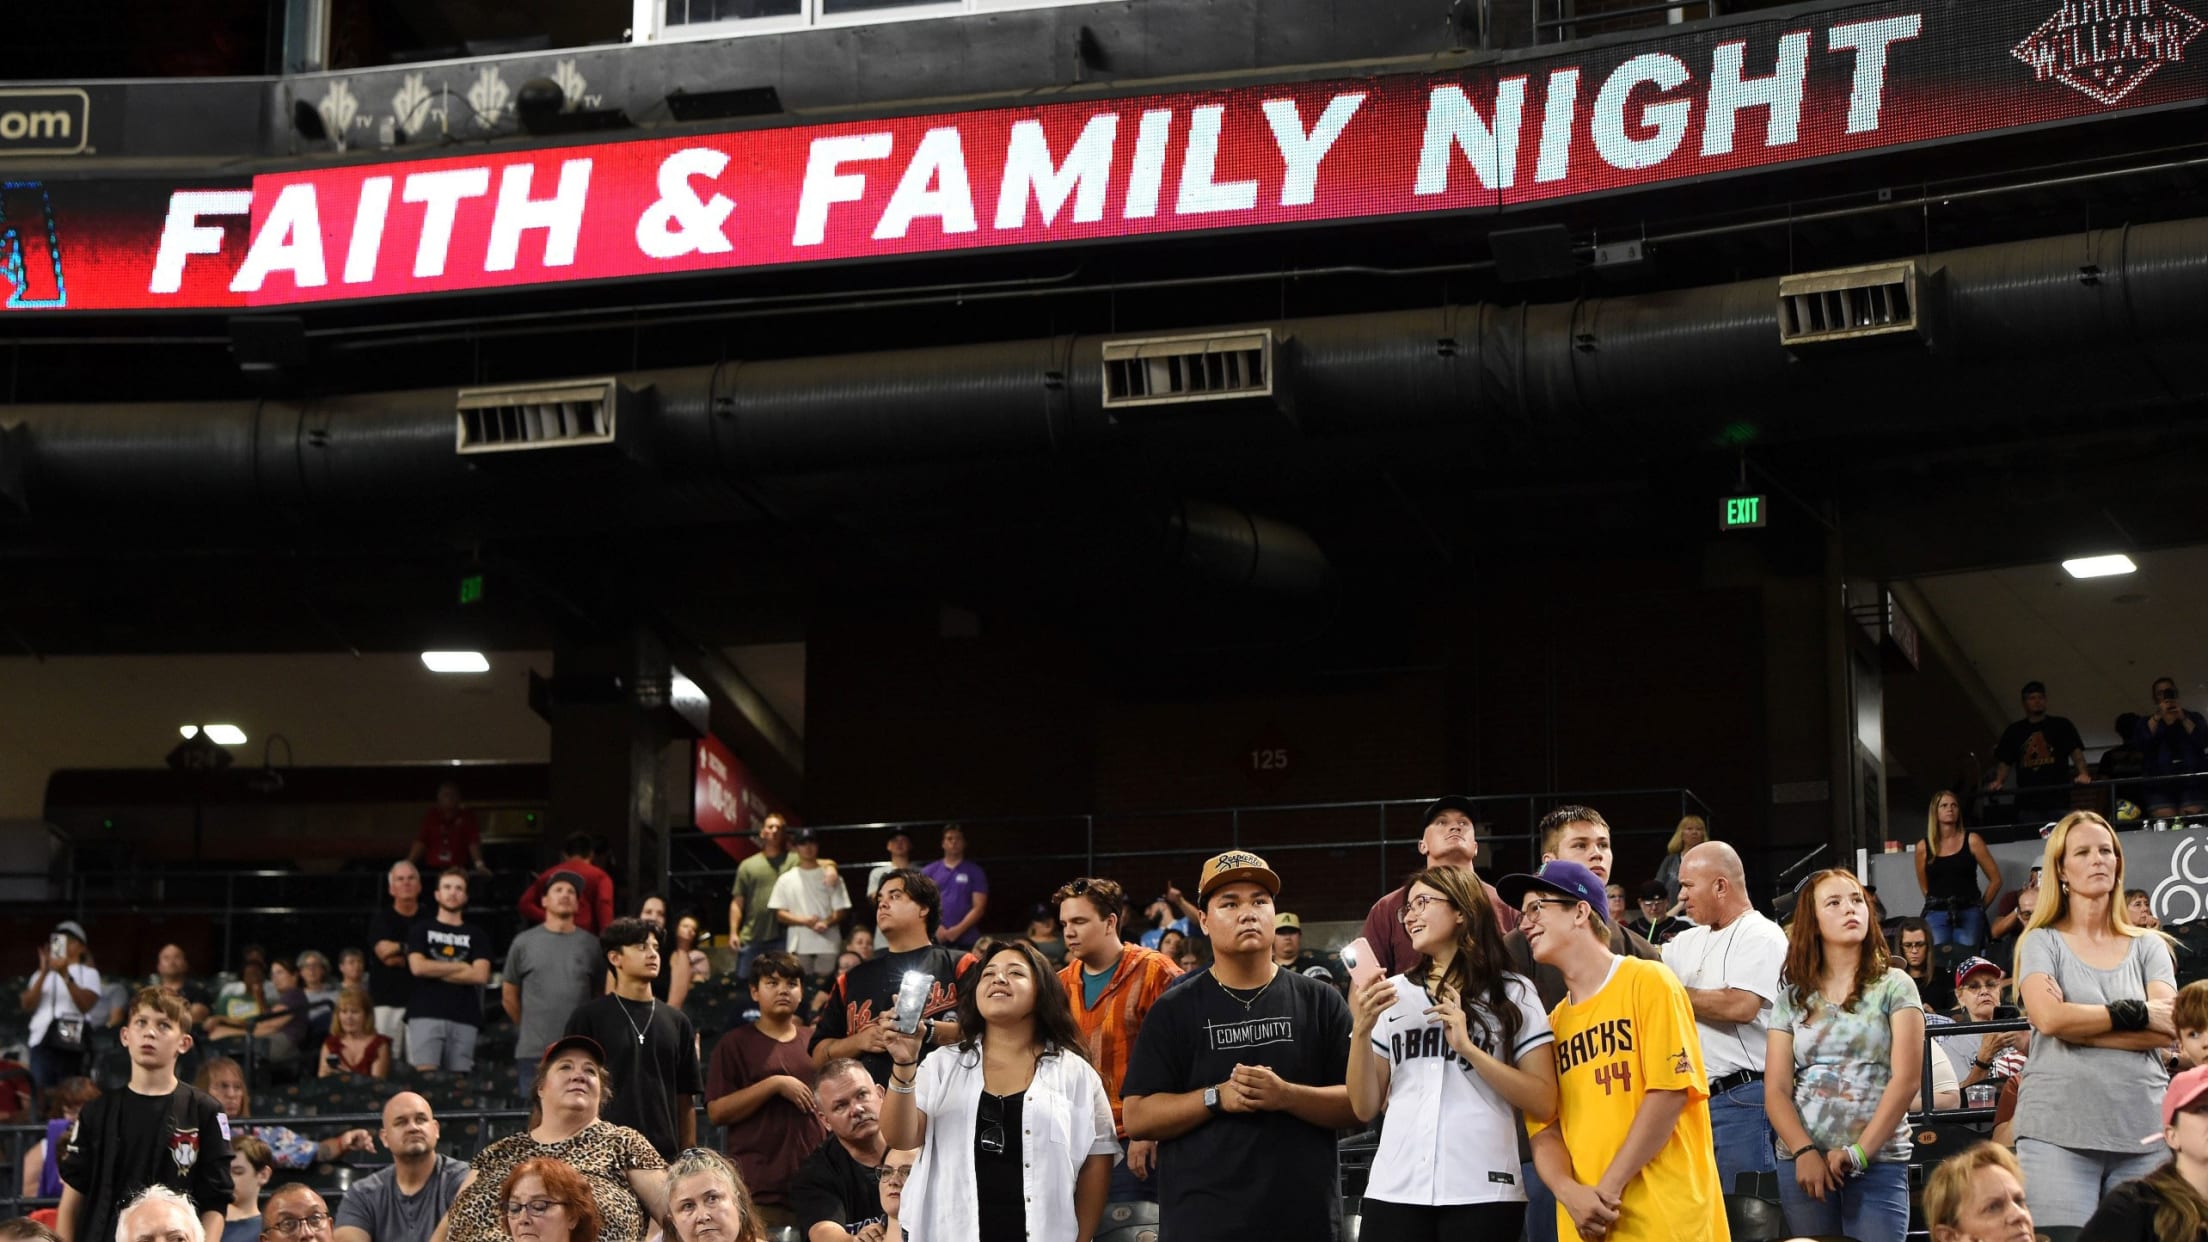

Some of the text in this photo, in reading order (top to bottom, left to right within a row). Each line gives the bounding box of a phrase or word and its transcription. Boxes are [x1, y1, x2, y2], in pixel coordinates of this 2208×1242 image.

[150, 13, 1922, 294] FAITH & FAMILY NIGHT
[1727, 497, 1759, 525] EXIT
[1251, 748, 1288, 769] 125
[1594, 1060, 1632, 1096] 44
